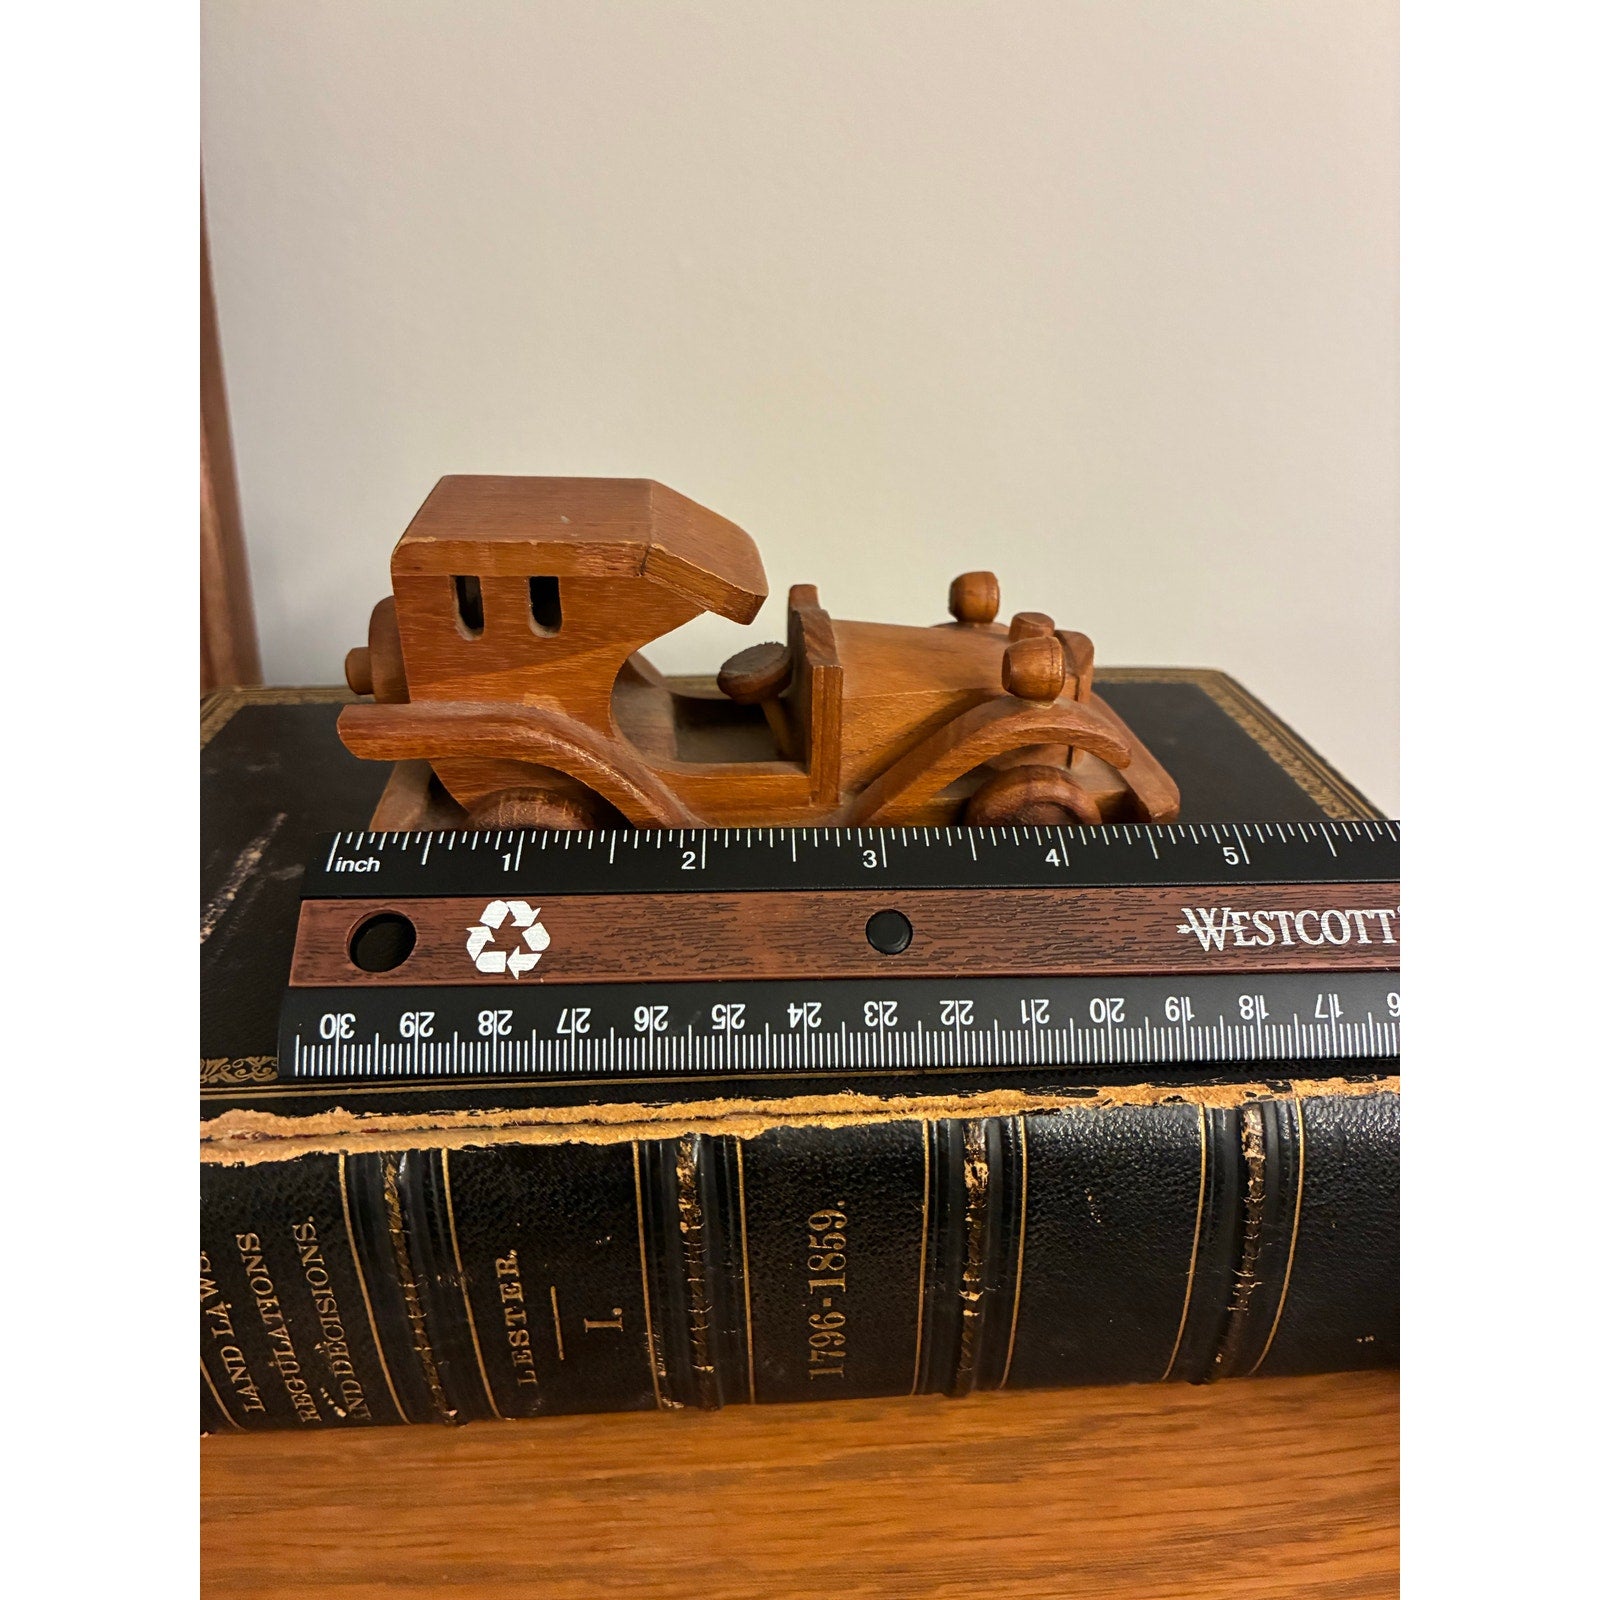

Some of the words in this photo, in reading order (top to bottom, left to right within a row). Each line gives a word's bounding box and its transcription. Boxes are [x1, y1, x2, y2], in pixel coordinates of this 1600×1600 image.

[335, 856, 380, 872] inch
[502, 853, 511, 872] 1
[681, 851, 697, 871] 2
[863, 849, 877, 868] 3
[1045, 848, 1060, 867] 4
[1225, 846, 1239, 866] 5
[1178, 906, 1398, 951] WESTCOTT
[634, 1006, 669, 1031] 26
[712, 1004, 746, 1030] 25
[787, 1002, 822, 1028] 24
[864, 1001, 898, 1026] 23
[940, 1000, 974, 1025] 22
[1021, 998, 1050, 1023] 21
[1089, 997, 1125, 1022] 20
[1165, 996, 1195, 1021] 19
[1239, 994, 1269, 1020] 18
[1314, 993, 1344, 1018] 17
[319, 1012, 356, 1039] 30
[400, 1012, 435, 1037] 29
[477, 1010, 513, 1035] 28
[556, 1008, 591, 1034] 27
[292, 1216, 355, 1378] DECISIONS.
[808, 1200, 847, 1380] 1796-1859.
[236, 1232, 322, 1422] REGULATIONS
[495, 1249, 538, 1387] LESTER.
[221, 1345, 266, 1413] LAND
